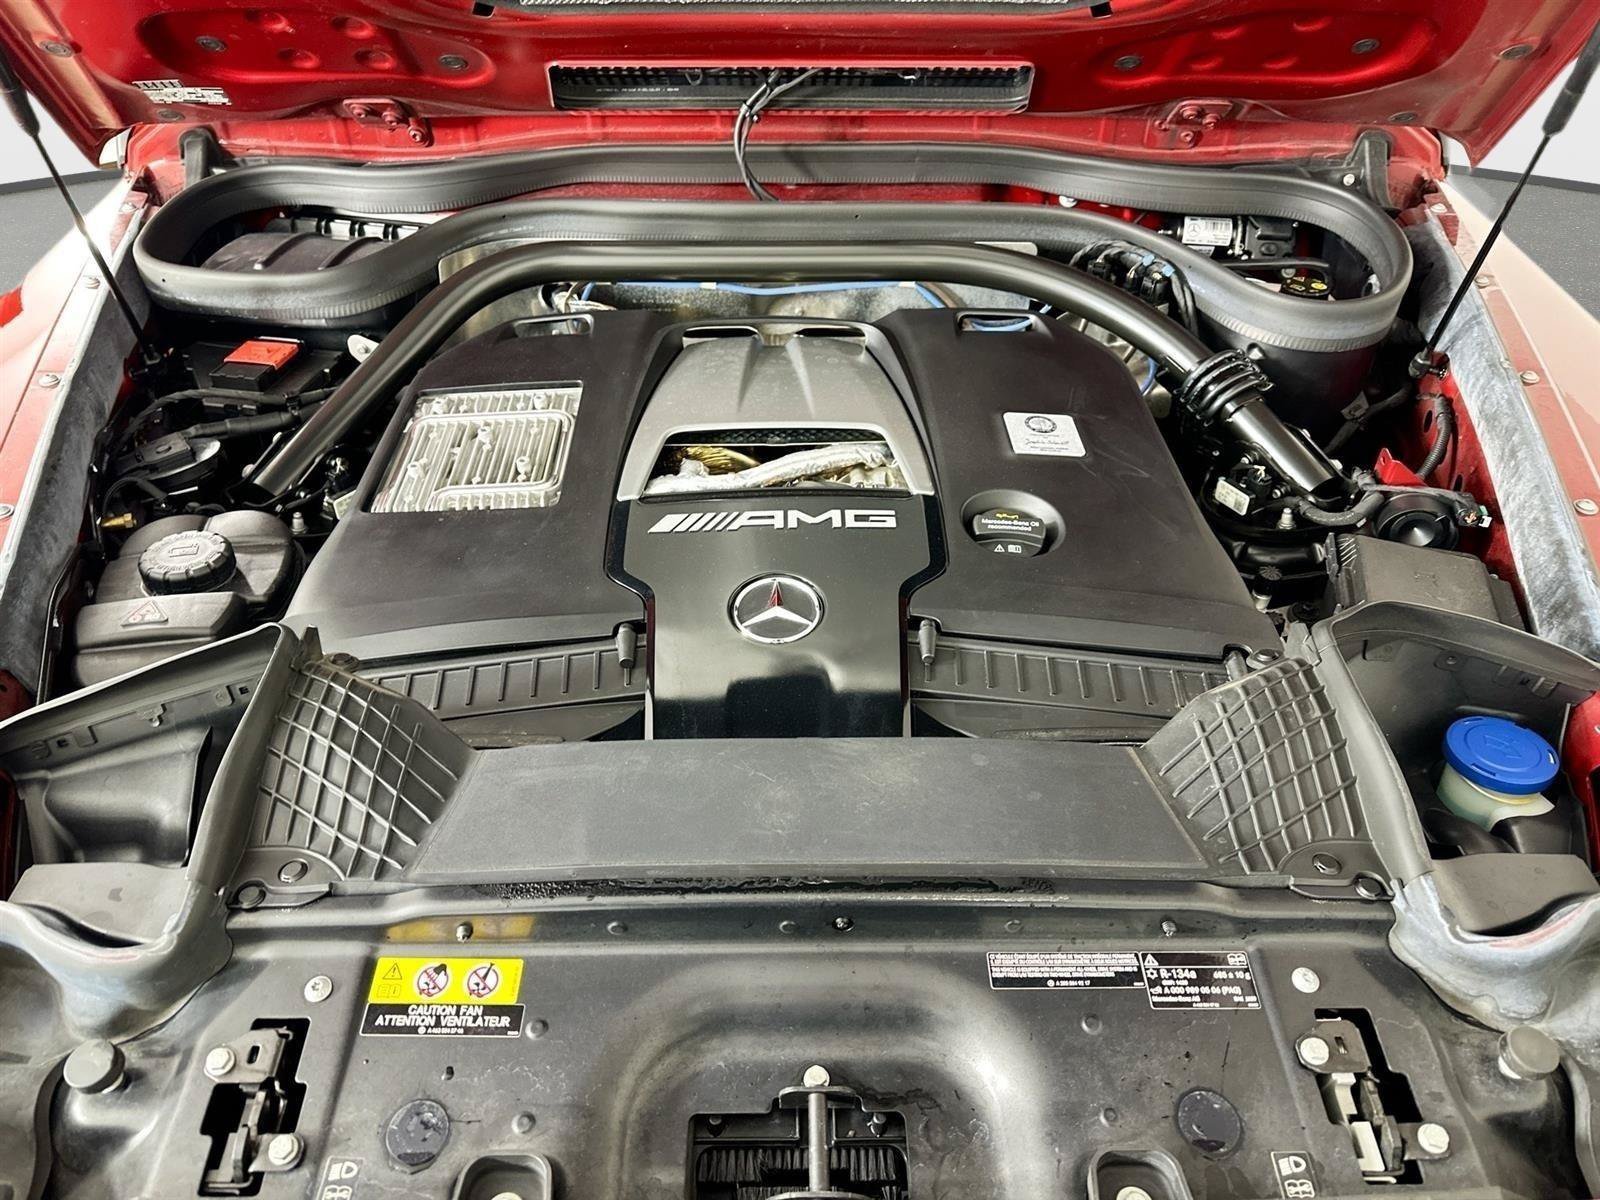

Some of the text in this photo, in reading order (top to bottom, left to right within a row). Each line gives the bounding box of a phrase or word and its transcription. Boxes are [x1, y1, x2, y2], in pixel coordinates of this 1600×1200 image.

[727, 509, 897, 531] AMG
[1160, 968, 1197, 979] R-134a
[408, 1004, 483, 1016] CAUTION FAN
[374, 1014, 511, 1028] ATTENTION VENTILATEUR
